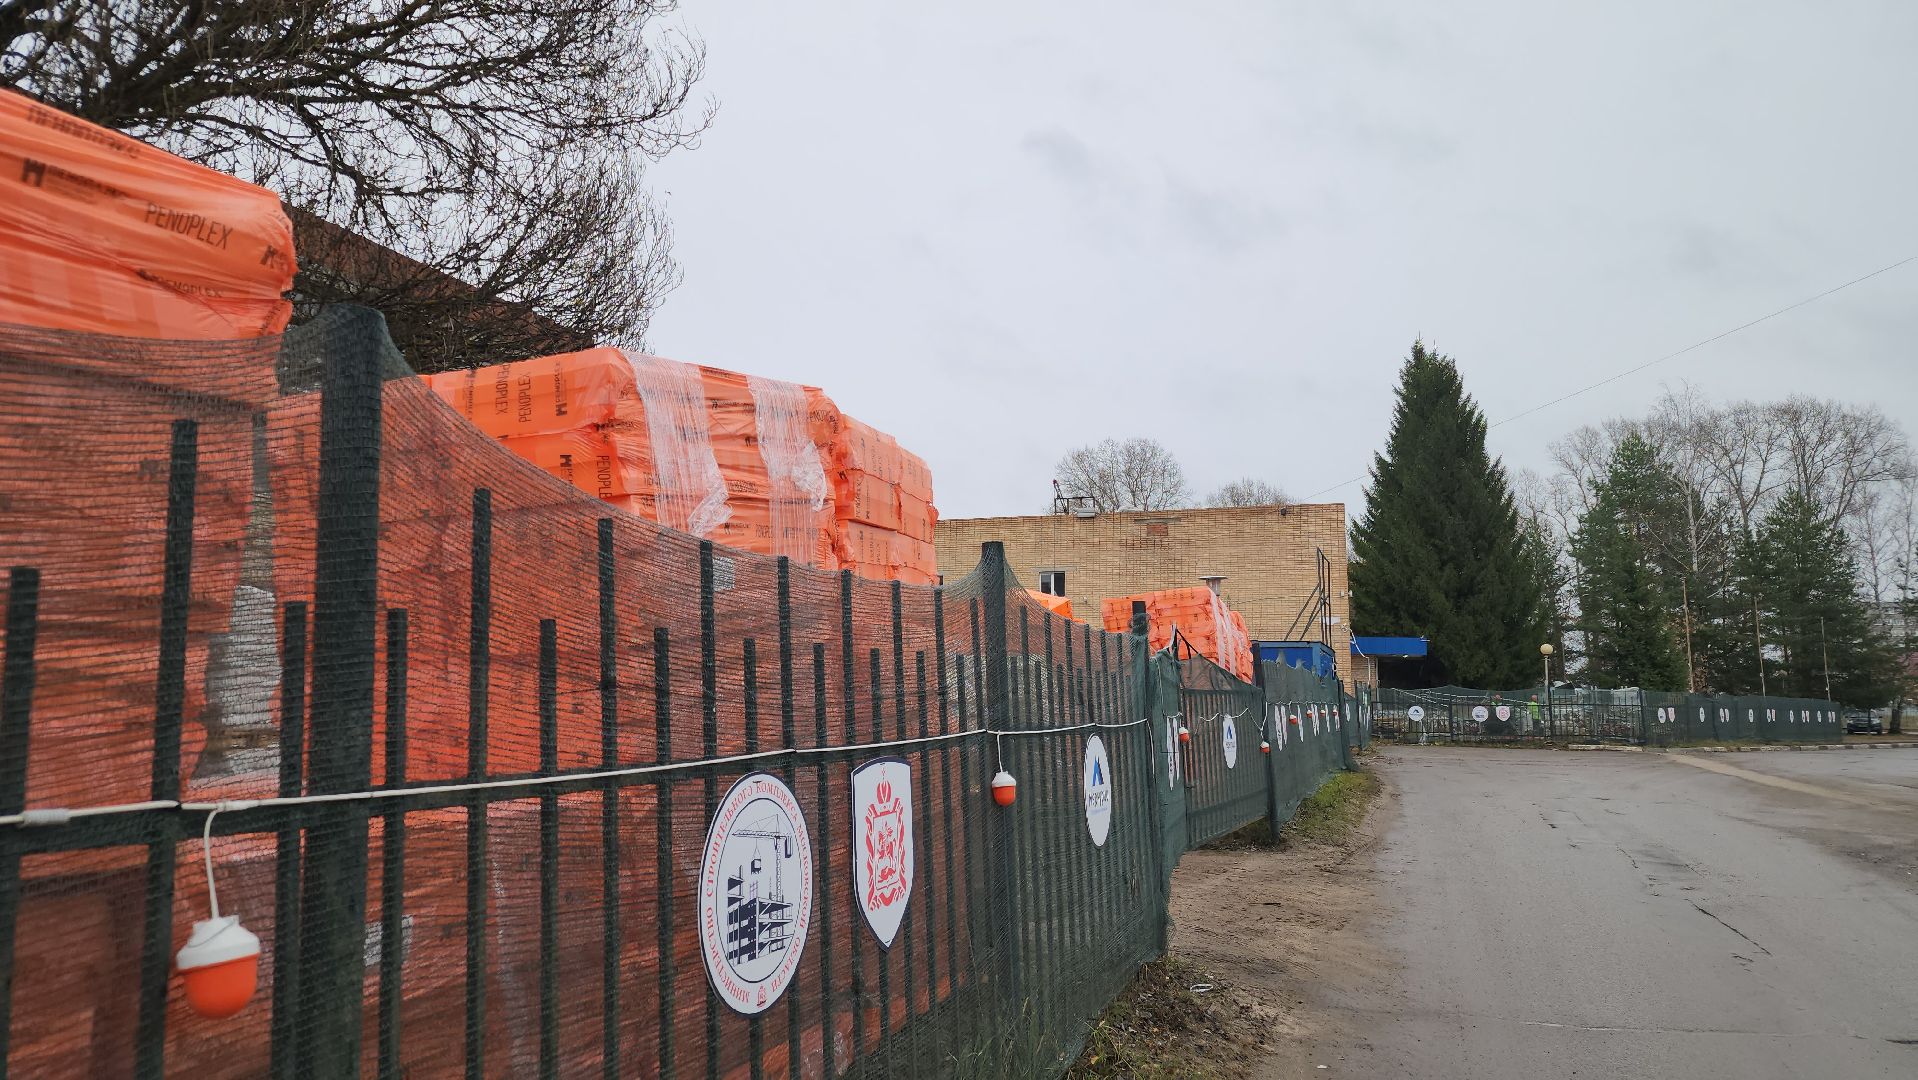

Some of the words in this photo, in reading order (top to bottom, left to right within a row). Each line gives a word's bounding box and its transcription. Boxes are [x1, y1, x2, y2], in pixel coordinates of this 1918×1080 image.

[144, 201, 234, 250] PENOPLEX
[495, 363, 512, 416] PENOPLEX
[518, 372, 532, 423] PENOPLEX
[756, 782, 798, 822] КОМПЛЕКСА
[706, 785, 753, 897] СТРОИТЕЛЬНОГО
[706, 907, 750, 1003] МИНИСТЕРСТВО
[771, 937, 801, 993] ОБЛАСТИ
